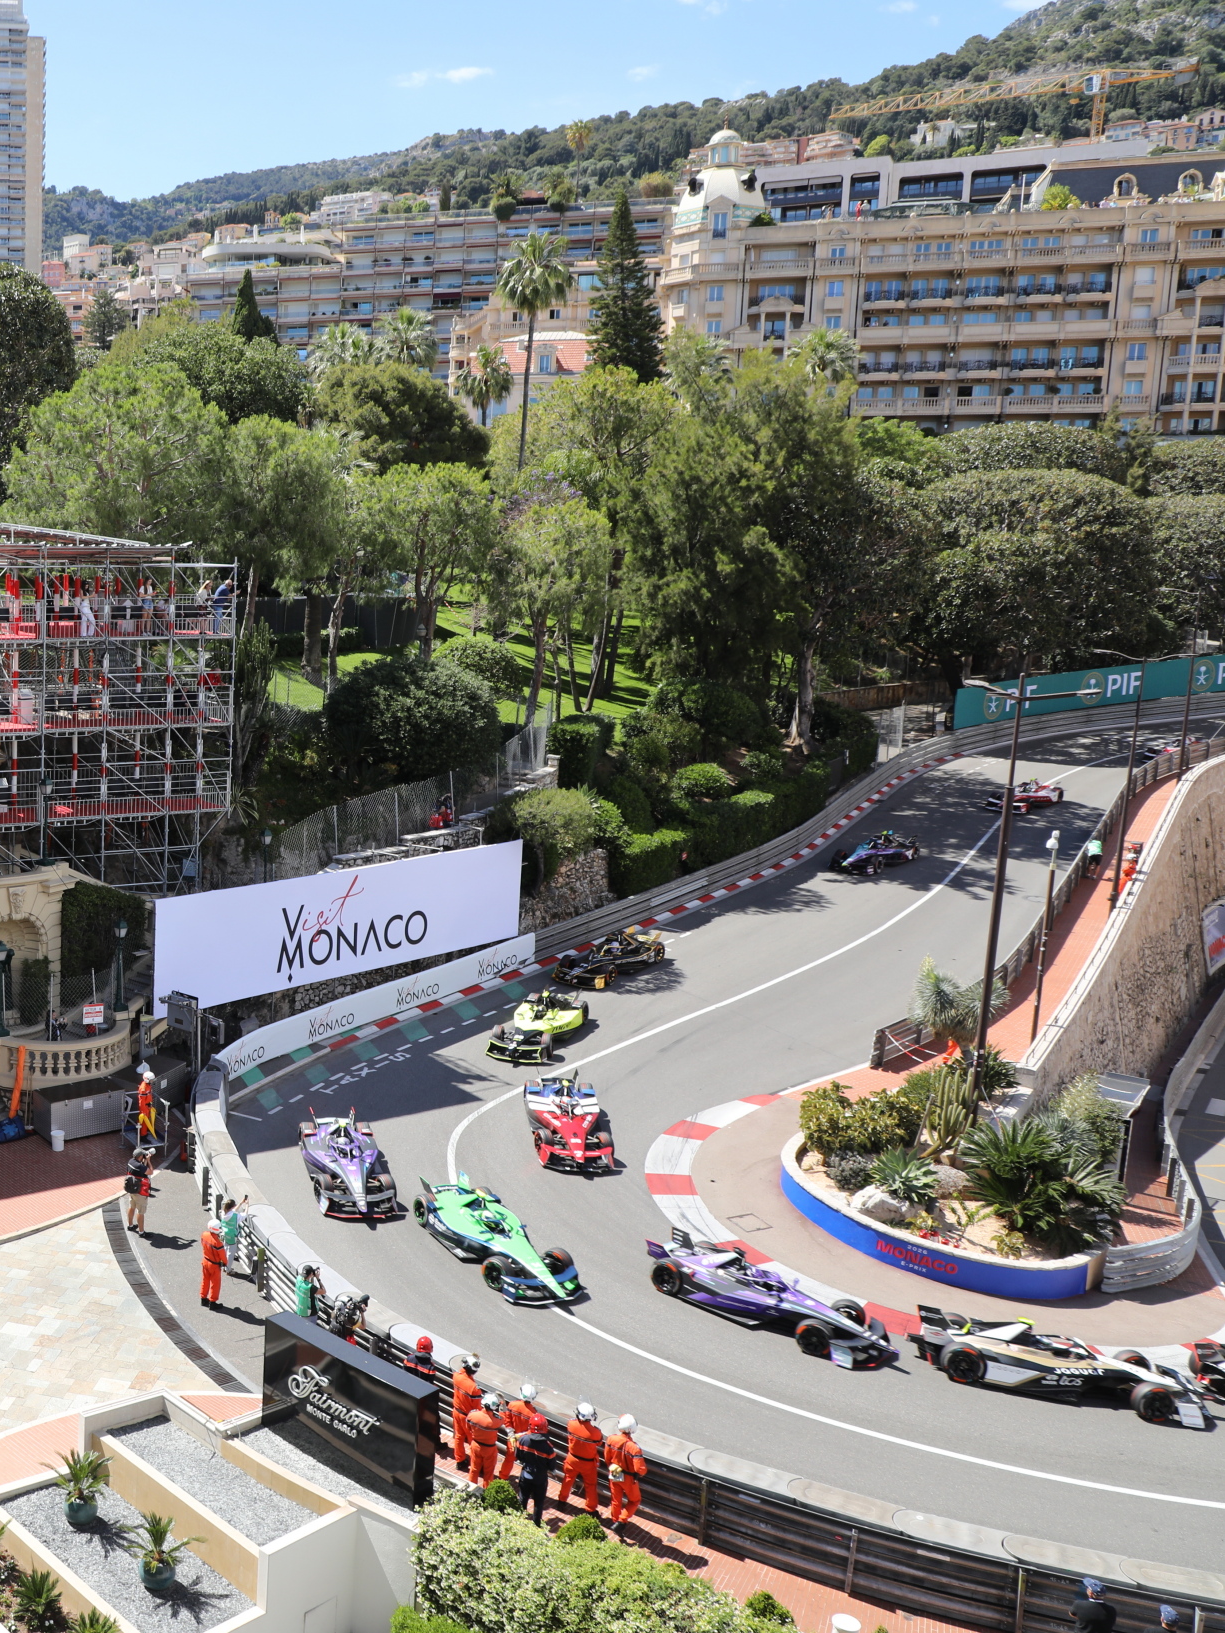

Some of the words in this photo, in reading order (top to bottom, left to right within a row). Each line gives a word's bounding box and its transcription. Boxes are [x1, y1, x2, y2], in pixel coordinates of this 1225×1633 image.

[1005, 684, 1038, 712] PF
[1106, 671, 1143, 698] PIF
[282, 874, 365, 943] Visit
[277, 910, 428, 975] MONACO
[396, 983, 440, 1008] MONACO
[308, 1012, 355, 1040] MONACO
[318, 1051, 412, 1095] TAXIS
[876, 1239, 959, 1275] MONACO
[906, 1244, 928, 1255] 2026
[900, 1260, 927, 1273] E-PRIX
[287, 1365, 381, 1435] Fairmont
[306, 1403, 332, 1425] MONTE
[333, 1419, 358, 1439] CARLO
